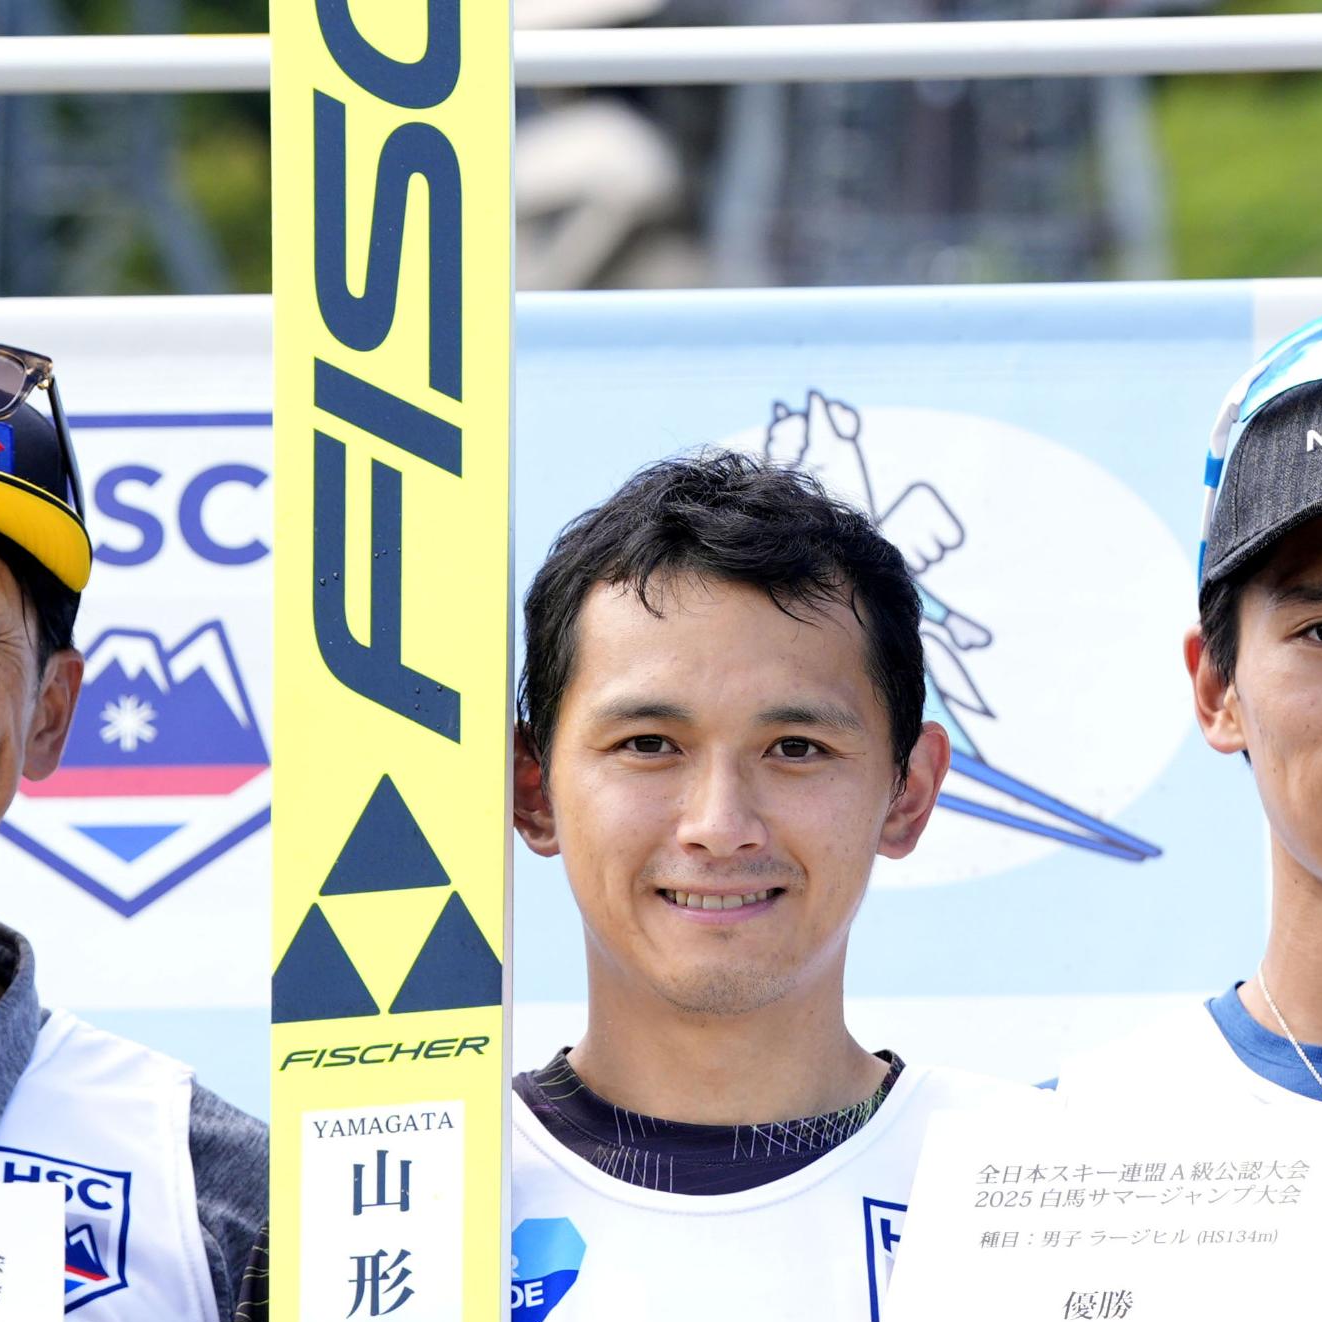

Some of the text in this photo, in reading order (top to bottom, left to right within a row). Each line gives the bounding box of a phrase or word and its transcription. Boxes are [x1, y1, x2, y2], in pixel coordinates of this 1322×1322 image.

[67, 464, 270, 567] SC
[279, 1036, 490, 1071] FISCHER
[313, 1112, 454, 1139] YAMAGATA
[1063, 1290, 1134, 1321] 優勝
